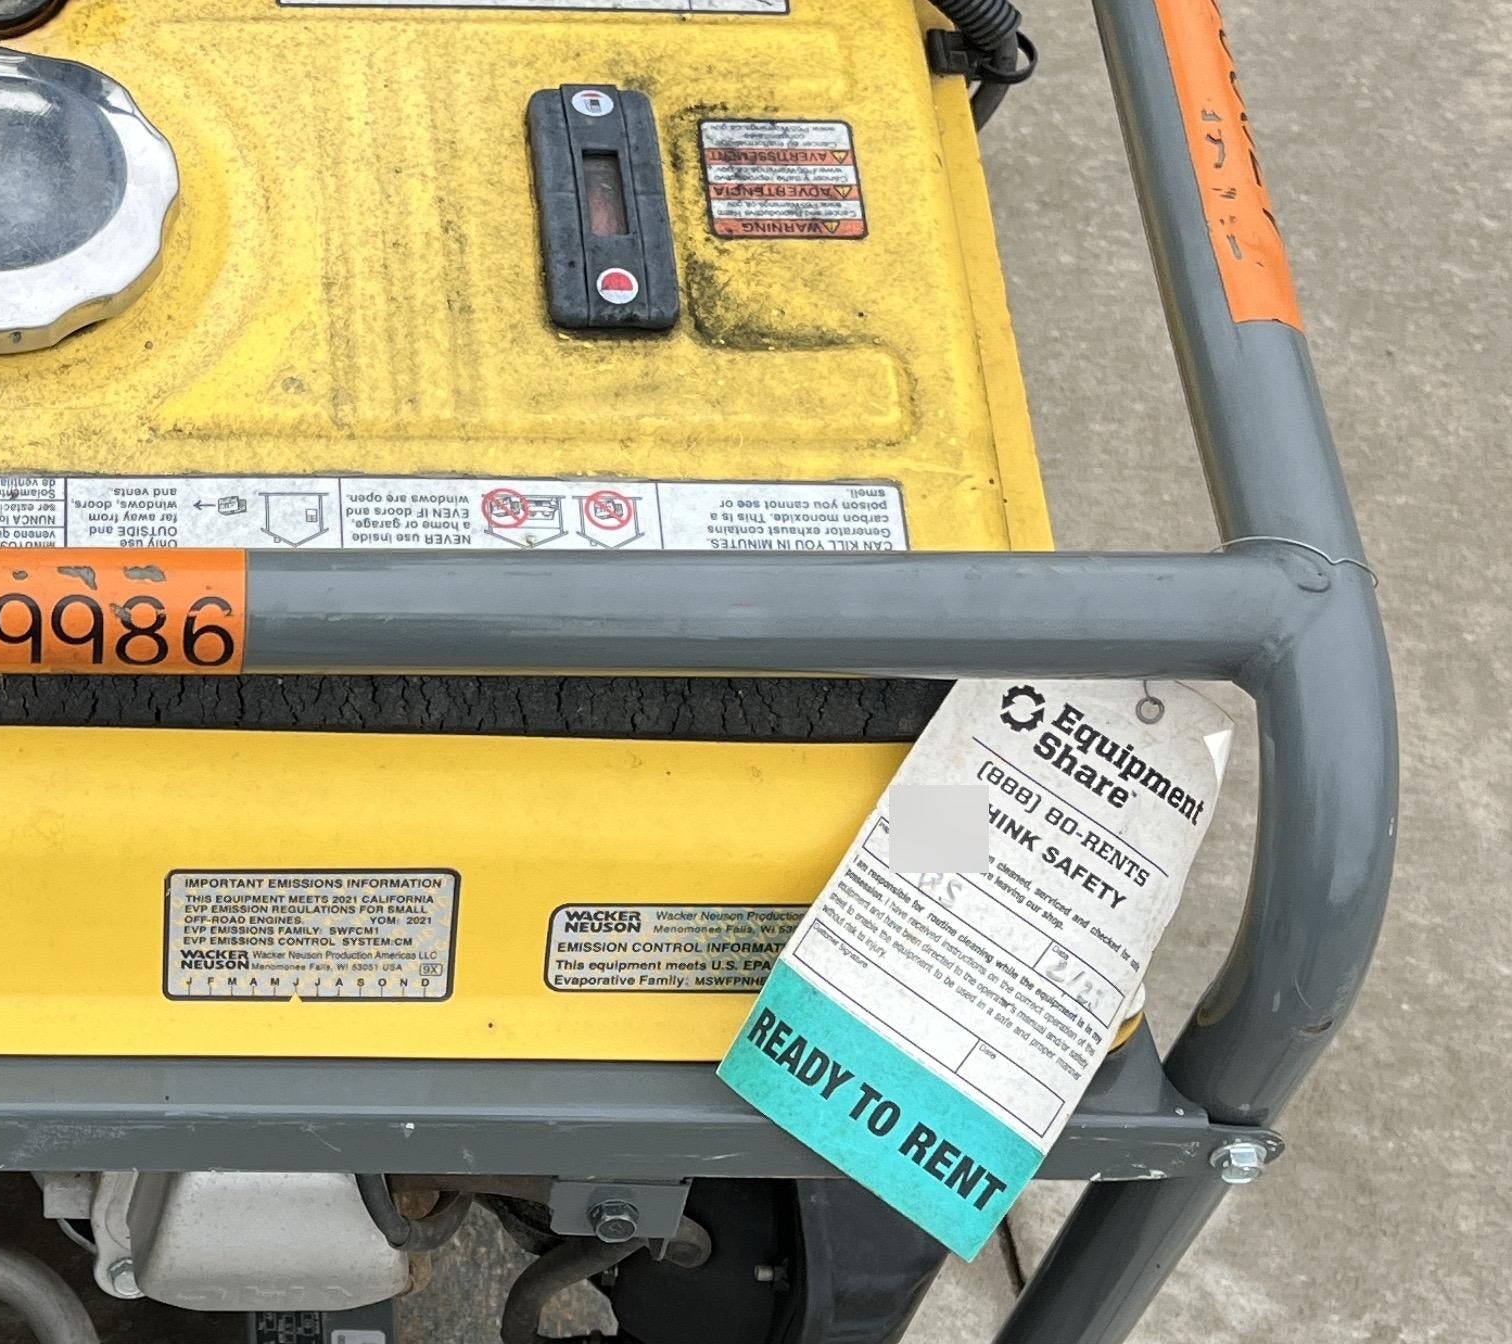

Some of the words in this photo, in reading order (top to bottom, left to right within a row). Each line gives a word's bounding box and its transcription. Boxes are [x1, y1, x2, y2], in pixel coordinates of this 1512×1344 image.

[713, 186, 831, 197] ADVERTENCIA
[742, 223, 822, 233] WARNING
[153, 488, 177, 497] and
[346, 492, 382, 503] open.
[846, 488, 885, 498] smell.
[386, 495, 407, 503] are
[411, 496, 469, 505] windows
[814, 499, 837, 509] you
[71, 499, 112, 510] doors,
[116, 500, 177, 510] windows,
[720, 500, 733, 509] or
[737, 500, 760, 509] see
[764, 500, 809, 511] cannot
[842, 500, 887, 511] poison
[123, 511, 155, 522] away
[346, 507, 370, 517] and
[374, 507, 412, 517] doors
[417, 508, 428, 518] IF
[433, 508, 469, 518] EVEN
[0, 515, 9, 525] lo
[13, 515, 55, 525] NUNCA
[89, 513, 118, 523] from
[160, 513, 177, 523] far
[722, 513, 733, 522] is
[737, 513, 765, 523] This
[771, 513, 839, 523] monoxide.
[843, 514, 889, 524] carbon
[351, 518, 400, 529] garage,
[405, 520, 418, 529] or
[422, 521, 459, 531] home
[463, 521, 470, 530] a
[89, 526, 113, 536] and
[118, 526, 177, 537] OUTSIDE
[707, 525, 764, 535] contains
[769, 526, 820, 536] exhaust
[825, 527, 891, 538] Generator
[120, 539, 143, 547] use
[352, 533, 392, 544] inside
[396, 534, 420, 542] use
[425, 534, 471, 544] NEVER
[707, 539, 772, 549] MINUTES.
[777, 539, 790, 549] IN
[795, 540, 824, 550] YOU
[828, 540, 858, 550] KILL
[864, 541, 892, 551] CAN
[1050, 702, 1205, 826] Equipment
[1033, 731, 1129, 808] Share
[977, 760, 1041, 813] (888)
[1044, 807, 1150, 887] 80-RENTS
[989, 804, 1041, 852] HINK
[1042, 846, 1127, 909] SAFETY
[185, 879, 265, 888] IMPORTANT
[269, 879, 342, 888] EMISSIONS
[347, 879, 442, 888] INFORMATION
[186, 895, 212, 903] THIS
[216, 895, 285, 903] EQUIPMENT
[996, 862, 1031, 892] cleaned,
[1034, 888, 1072, 916] serviced
[1072, 914, 1090, 929] and
[185, 905, 207, 913] EVP
[211, 905, 268, 913] EMISSION
[185, 916, 245, 924] OFF-ROAD
[565, 910, 641, 922] WACKER
[656, 911, 698, 921] Wacker
[701, 911, 743, 922] Neuson
[747, 911, 804, 922] Production
[868, 868, 912, 904] responsible
[927, 912, 957, 937] routine
[958, 933, 994, 963] cleaning
[184, 926, 206, 934] EVP
[210, 926, 274, 935] EMISSIONS
[565, 922, 641, 933] NEUSON
[654, 925, 722, 934] Menomonee
[184, 937, 206, 945] EVP
[210, 937, 274, 945] EMISSIONS
[278, 937, 335, 946] CONTROL
[558, 942, 627, 953] EMISSION
[632, 942, 702, 953] CONTROL
[706, 942, 786, 953] INFORMAT
[180, 950, 249, 959] WACKER
[253, 951, 285, 959] Wacker
[289, 951, 322, 959] Neuson
[326, 951, 372, 960] Production
[375, 952, 416, 960] Americas
[419, 952, 437, 960] LLC
[181, 960, 249, 969] NEUSON
[555, 960, 585, 971] This
[588, 960, 662, 972] equipment
[665, 961, 707, 971] meets
[711, 960, 738, 971] U.S.
[743, 960, 771, 971] EPA
[423, 966, 438, 974] 9X
[554, 976, 636, 987] Evaporative
[747, 1008, 854, 1099] READY
[846, 1079, 902, 1138] TO
[898, 1128, 1008, 1212] RENT
